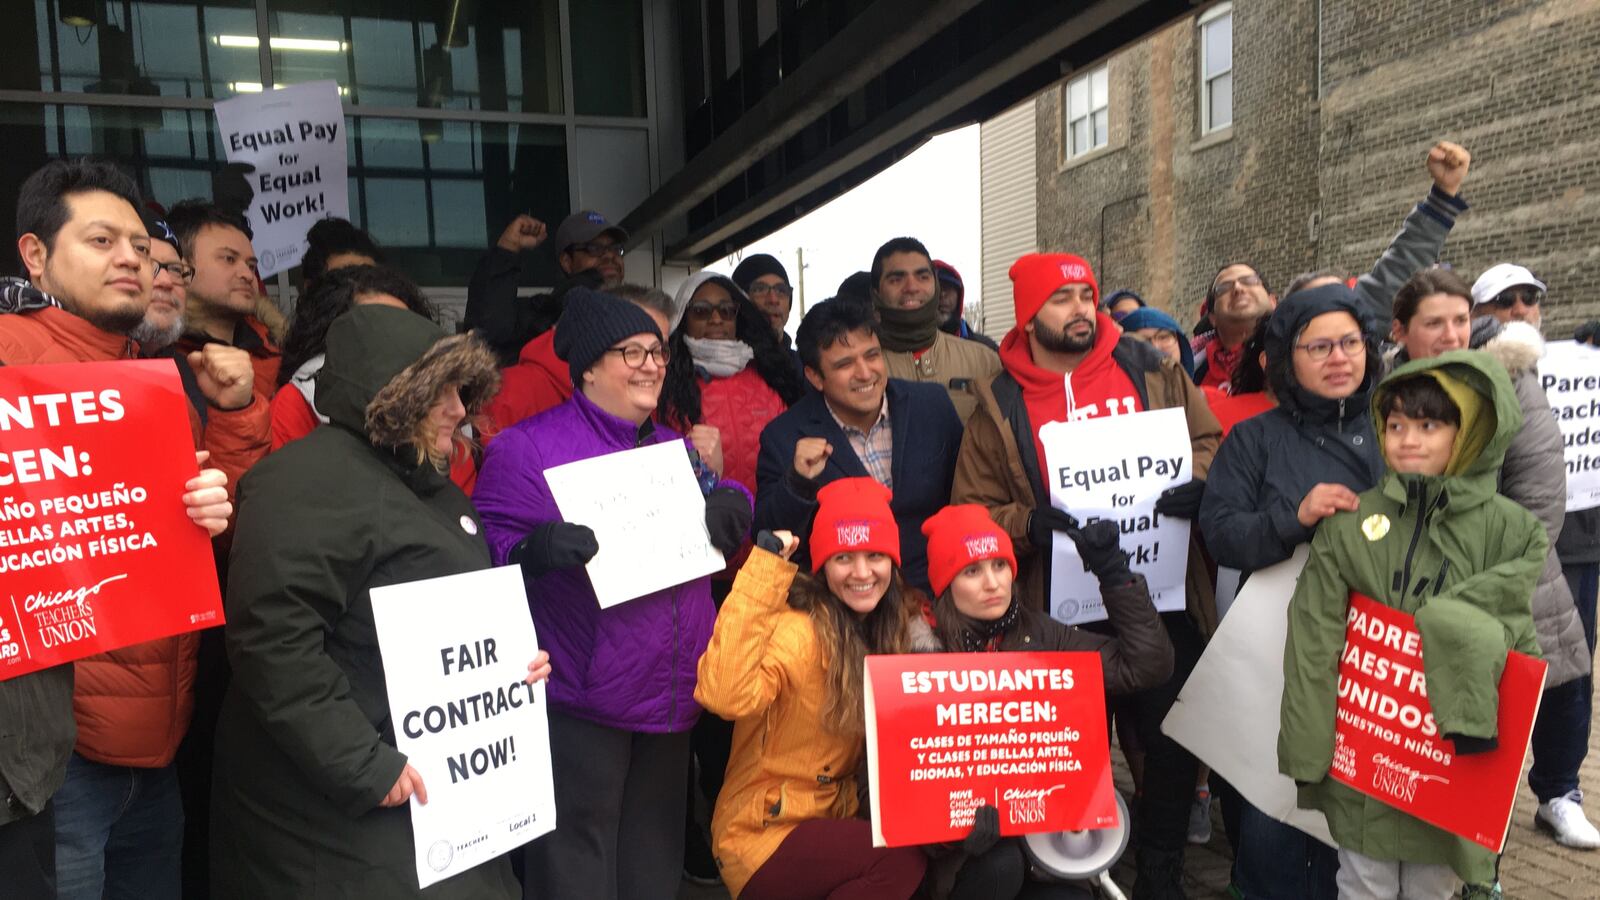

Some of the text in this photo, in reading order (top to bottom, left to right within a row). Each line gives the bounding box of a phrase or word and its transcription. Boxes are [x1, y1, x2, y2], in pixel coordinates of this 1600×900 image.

[230, 121, 338, 152] Equal Pay
[278, 152, 300, 165] for
[259, 166, 322, 193] Equal
[261, 192, 325, 224] Work!
[1542, 374, 1600, 393] Pare
[1058, 456, 1184, 491] Equal Pay
[40, 482, 147, 516] PEQUEÑO
[1111, 493, 1136, 508] for
[60, 512, 135, 538] ARTES,
[1087, 511, 1160, 535] ual
[88, 532, 158, 557] FÍSICA
[1123, 541, 1160, 565] rk!
[25, 573, 128, 613] Chicago
[34, 601, 93, 627] TEACHERS
[38, 616, 97, 648] UNION
[1347, 606, 1423, 659] PADRE
[440, 637, 499, 676] FAIR
[1341, 640, 1428, 698] AESTR
[901, 668, 1075, 694] ESTUDIANTES
[402, 680, 536, 739] CONTRACT
[936, 701, 1057, 726] MERECEN:
[1337, 674, 1438, 737] UNIDOS
[910, 726, 1080, 749] CLASES DE TAMAÑO PEQUEÑO
[1336, 707, 1452, 766] NUESTROS NIÑOS
[446, 735, 517, 784] NOW!
[917, 745, 1073, 765] Y CLASES DE BELLAS ARTES,
[910, 758, 1082, 781] IDIOMAS, Y EDUCACIÓN FÍSICA
[1003, 784, 1066, 802] Chicago
[1372, 770, 1416, 804] UNION
[949, 797, 986, 810] CHICAGO
[1009, 808, 1046, 825] UNION
[509, 815, 531, 832] Local
[457, 834, 489, 852] TEACHERS
